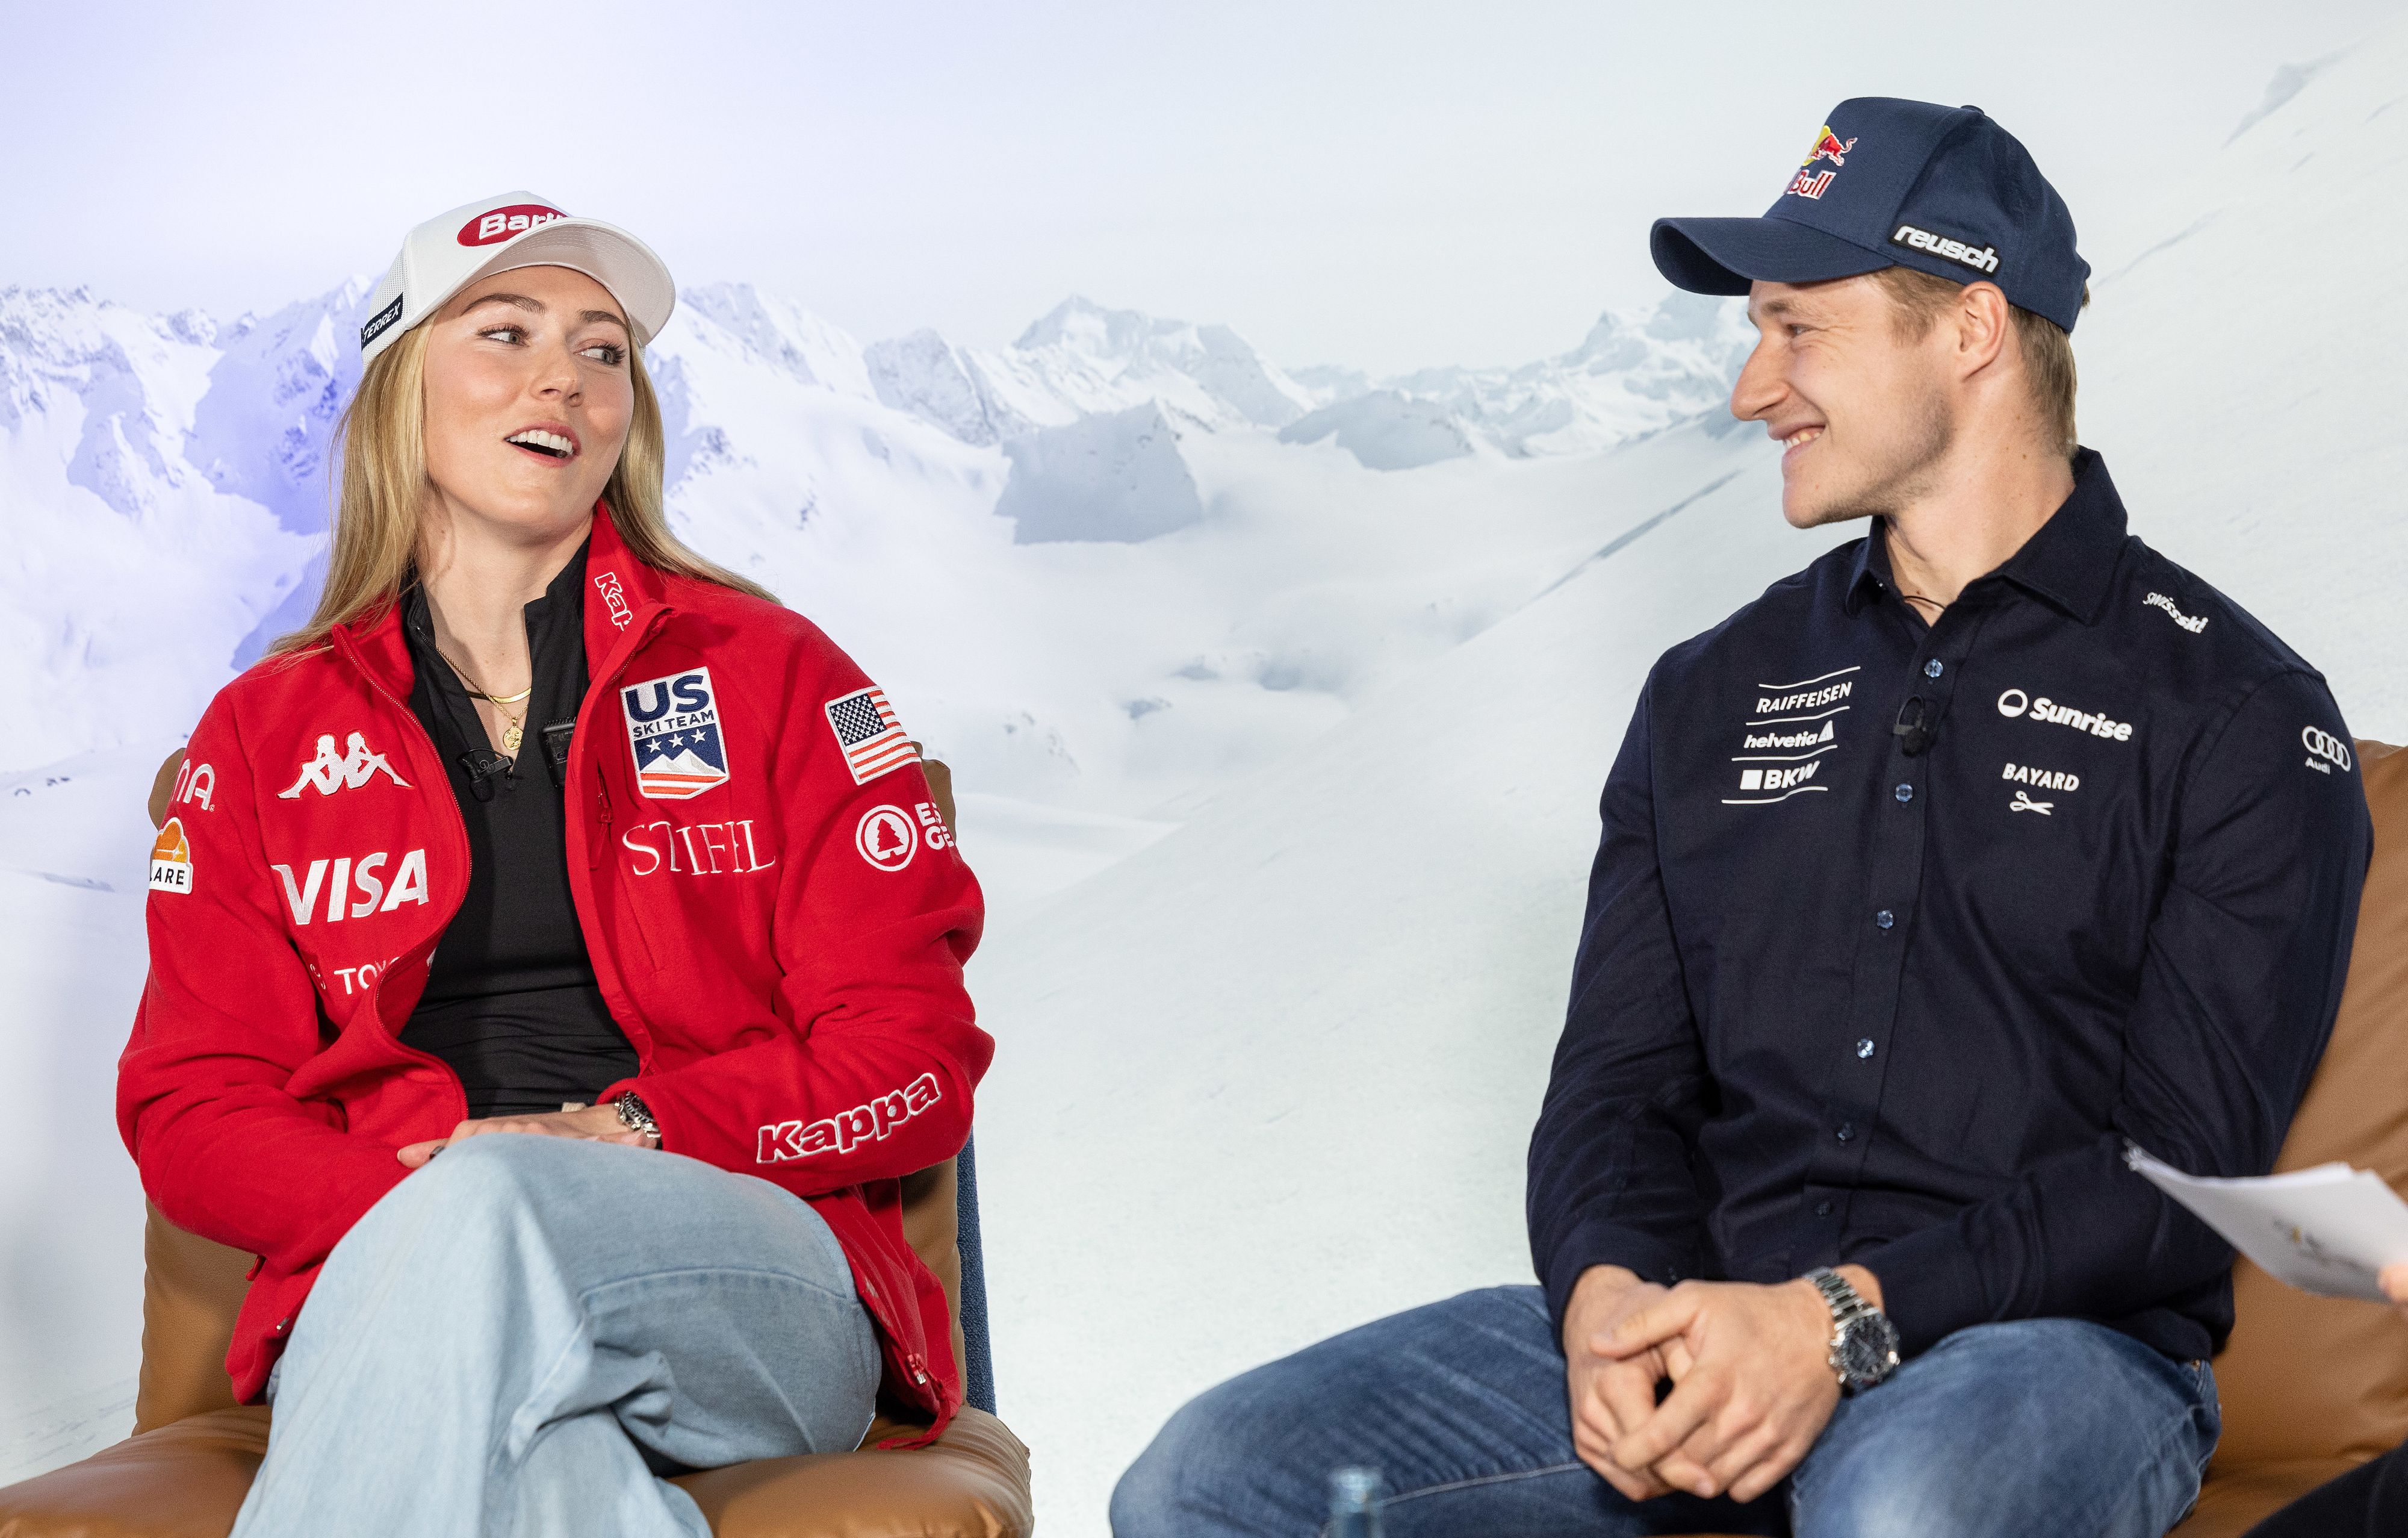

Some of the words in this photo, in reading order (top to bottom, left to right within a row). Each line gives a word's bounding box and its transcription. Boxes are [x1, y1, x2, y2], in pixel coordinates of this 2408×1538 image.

[1893, 225, 1999, 273] reusch
[364, 302, 401, 343] TERREX
[625, 674, 710, 723] US
[1755, 681, 1852, 714] RAIFFEISEN
[633, 721, 662, 738] SKI
[665, 709, 715, 730] TEAM
[2029, 697, 2133, 741] Sunrise
[1743, 730, 1819, 749] helvetia
[1763, 760, 1820, 790] BKW
[2002, 762, 2080, 792] BAYARD
[2305, 756, 2330, 775] Audi
[271, 848, 430, 926] VISA
[756, 1072, 942, 1164] Kappa
